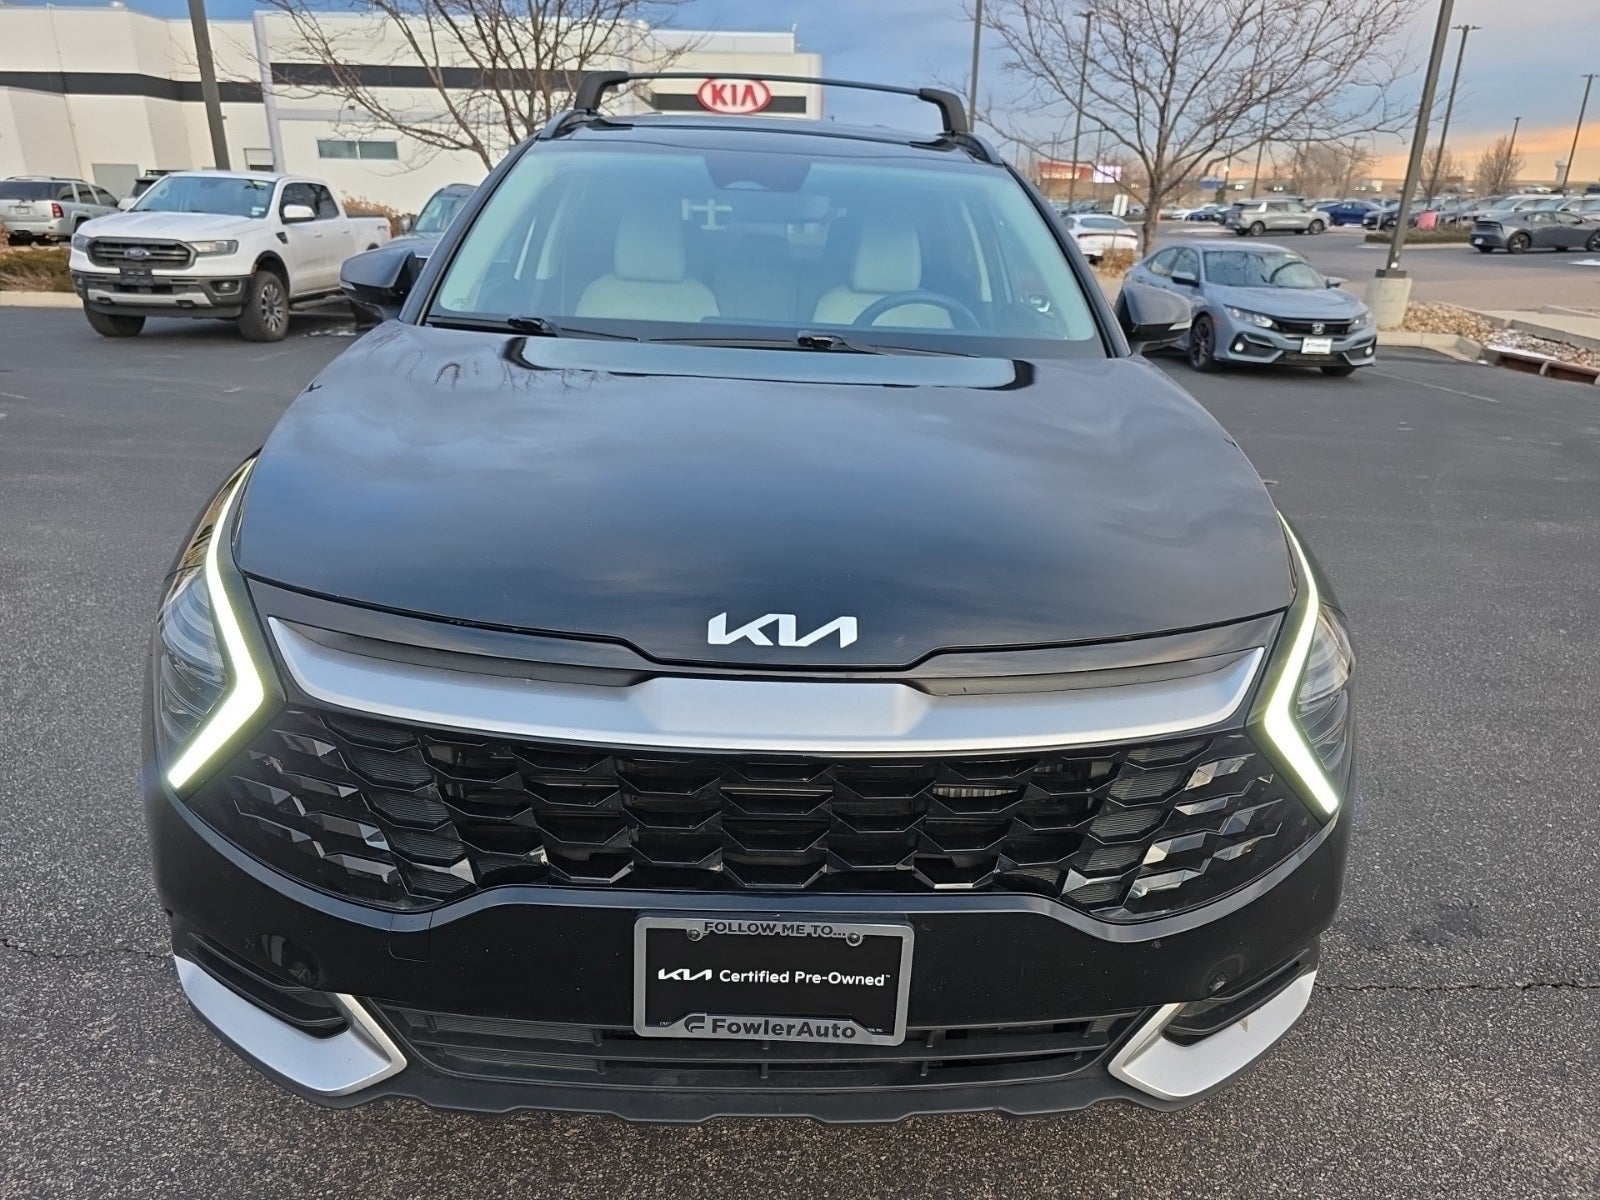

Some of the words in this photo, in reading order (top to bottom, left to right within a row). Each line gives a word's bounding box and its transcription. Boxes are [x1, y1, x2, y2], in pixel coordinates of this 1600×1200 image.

[711, 84, 758, 107] KIA
[703, 921, 776, 935] FOLLOW
[781, 924, 805, 936] ME
[719, 969, 789, 983] Certified
[711, 1018, 857, 1039] FowlerAuto
